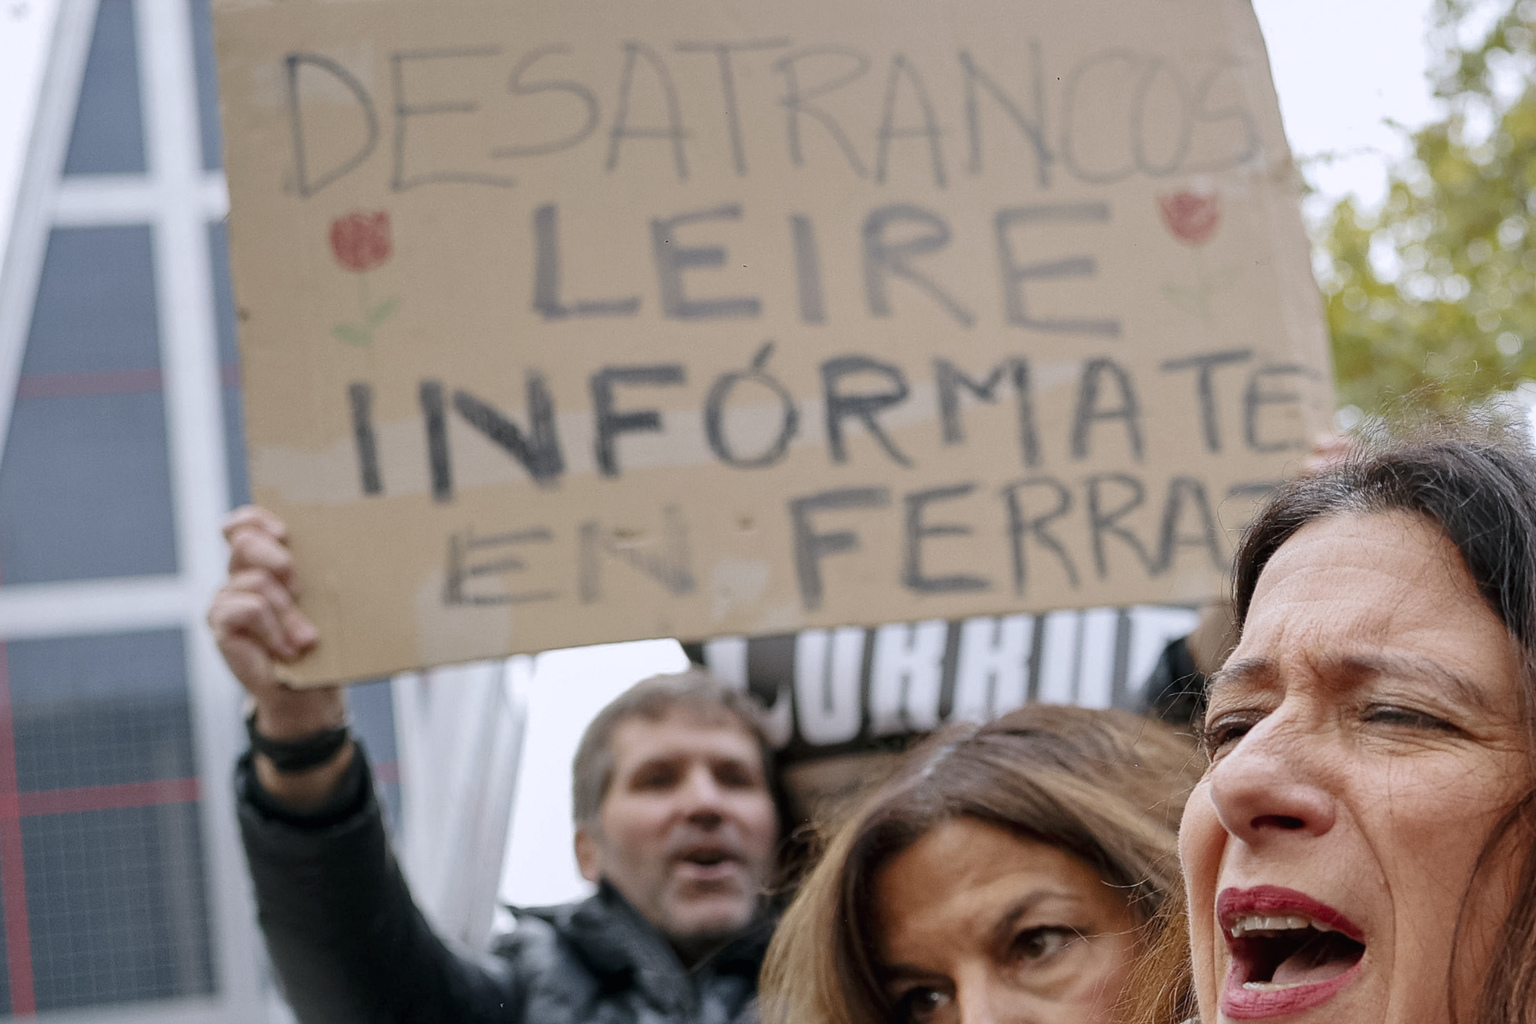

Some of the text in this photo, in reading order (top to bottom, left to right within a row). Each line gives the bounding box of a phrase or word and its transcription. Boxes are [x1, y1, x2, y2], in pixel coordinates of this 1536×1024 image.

[284, 37, 1264, 198] DESATRANCOS
[530, 204, 1122, 337] LEIRE
[345, 342, 1322, 506] INFÓRMATE
[442, 503, 698, 606] EN
